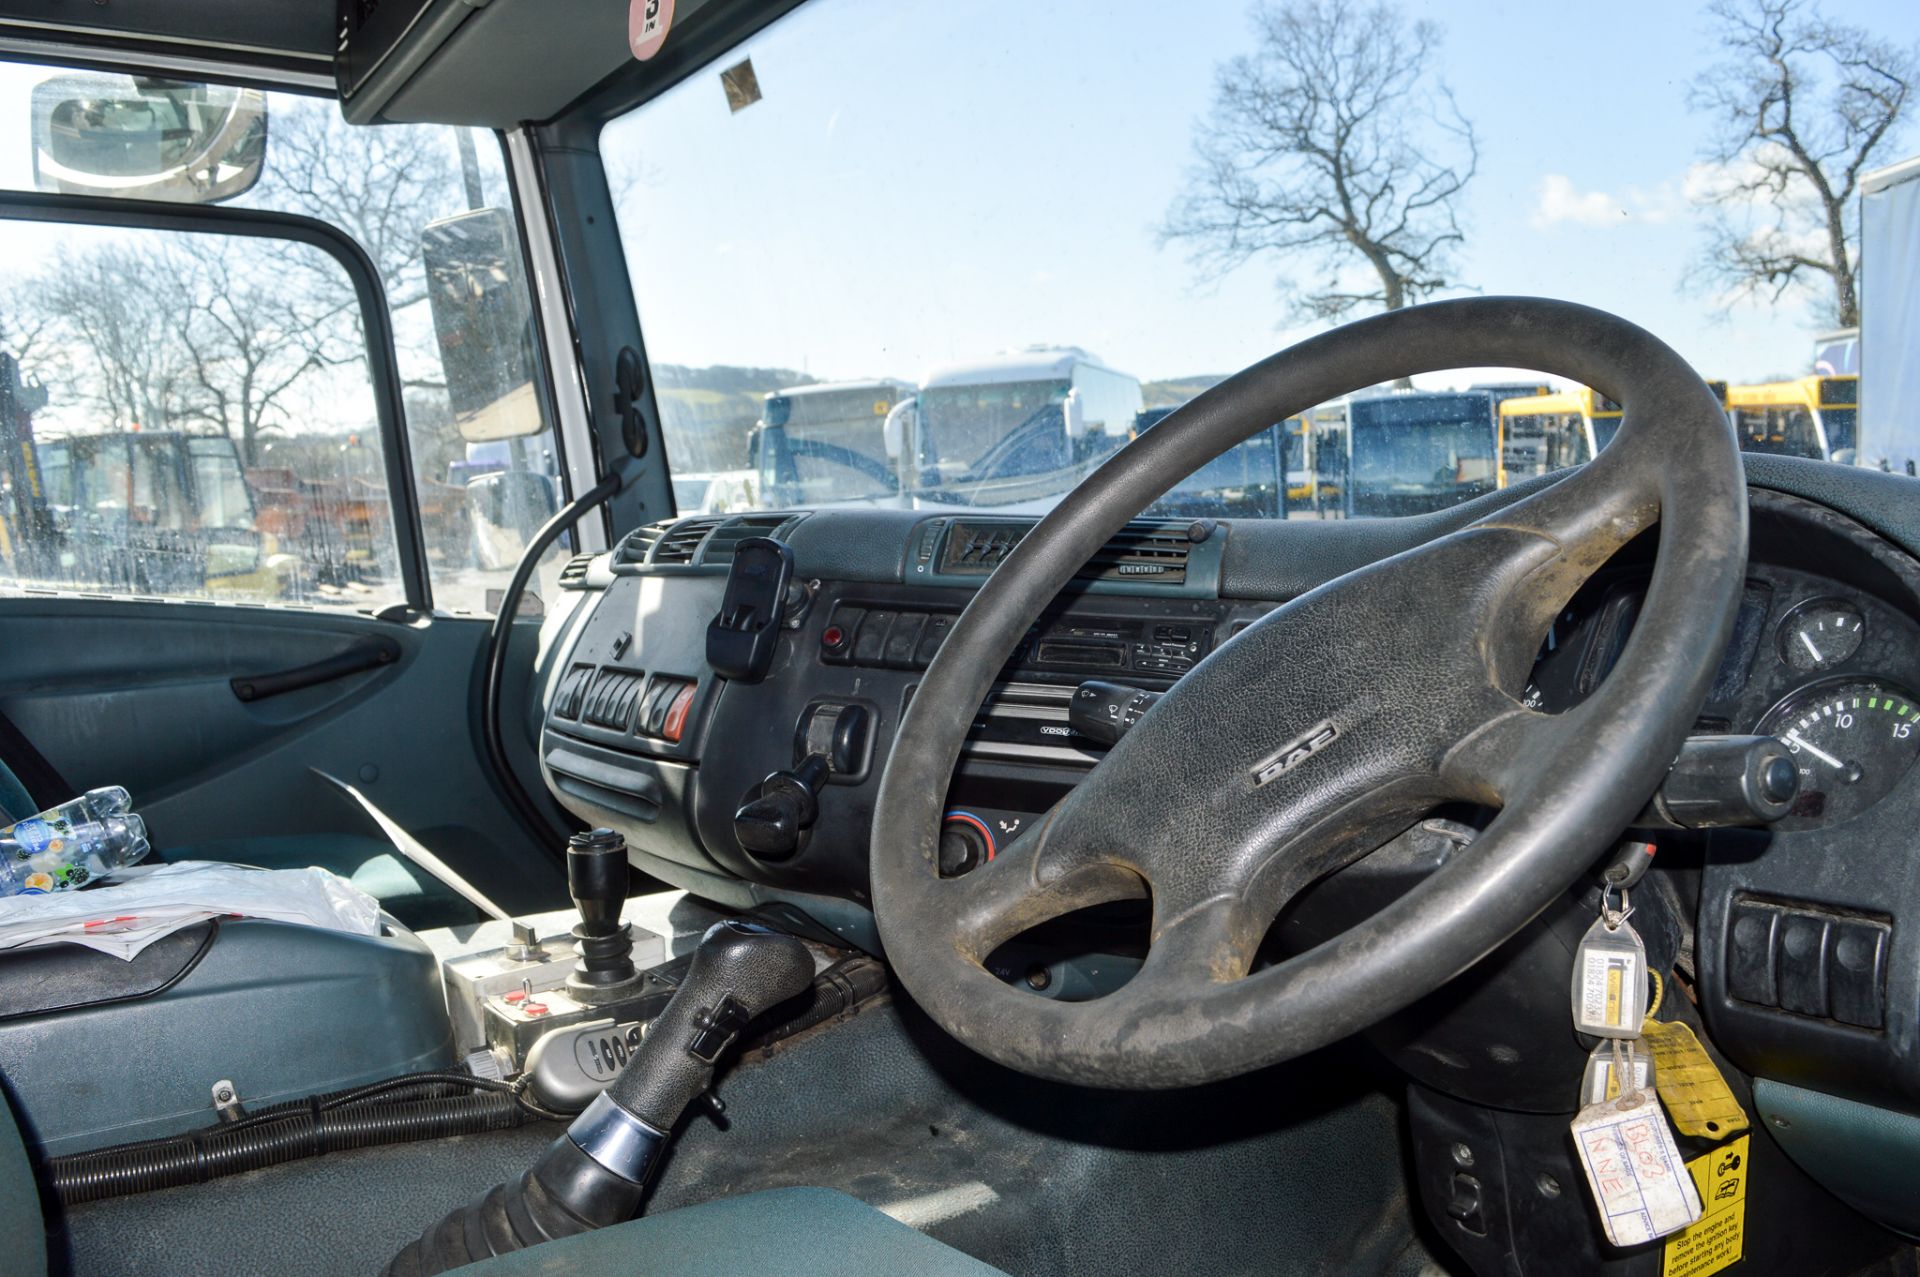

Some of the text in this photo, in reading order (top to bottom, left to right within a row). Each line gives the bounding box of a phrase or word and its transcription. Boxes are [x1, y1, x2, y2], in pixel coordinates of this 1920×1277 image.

[645, 20, 655, 33] IN
[1835, 713, 1853, 729] 10
[1893, 723, 1912, 739] 15
[1257, 729, 1333, 785] DAF
[1672, 1223, 1738, 1264] remove the ignition key
[1677, 1212, 1735, 1250] Stop the engine and
[1668, 1262, 1689, 1276] before
[1690, 1248, 1713, 1265] starting
[1714, 1241, 1725, 1251] any
[1726, 1232, 1740, 1244] body
